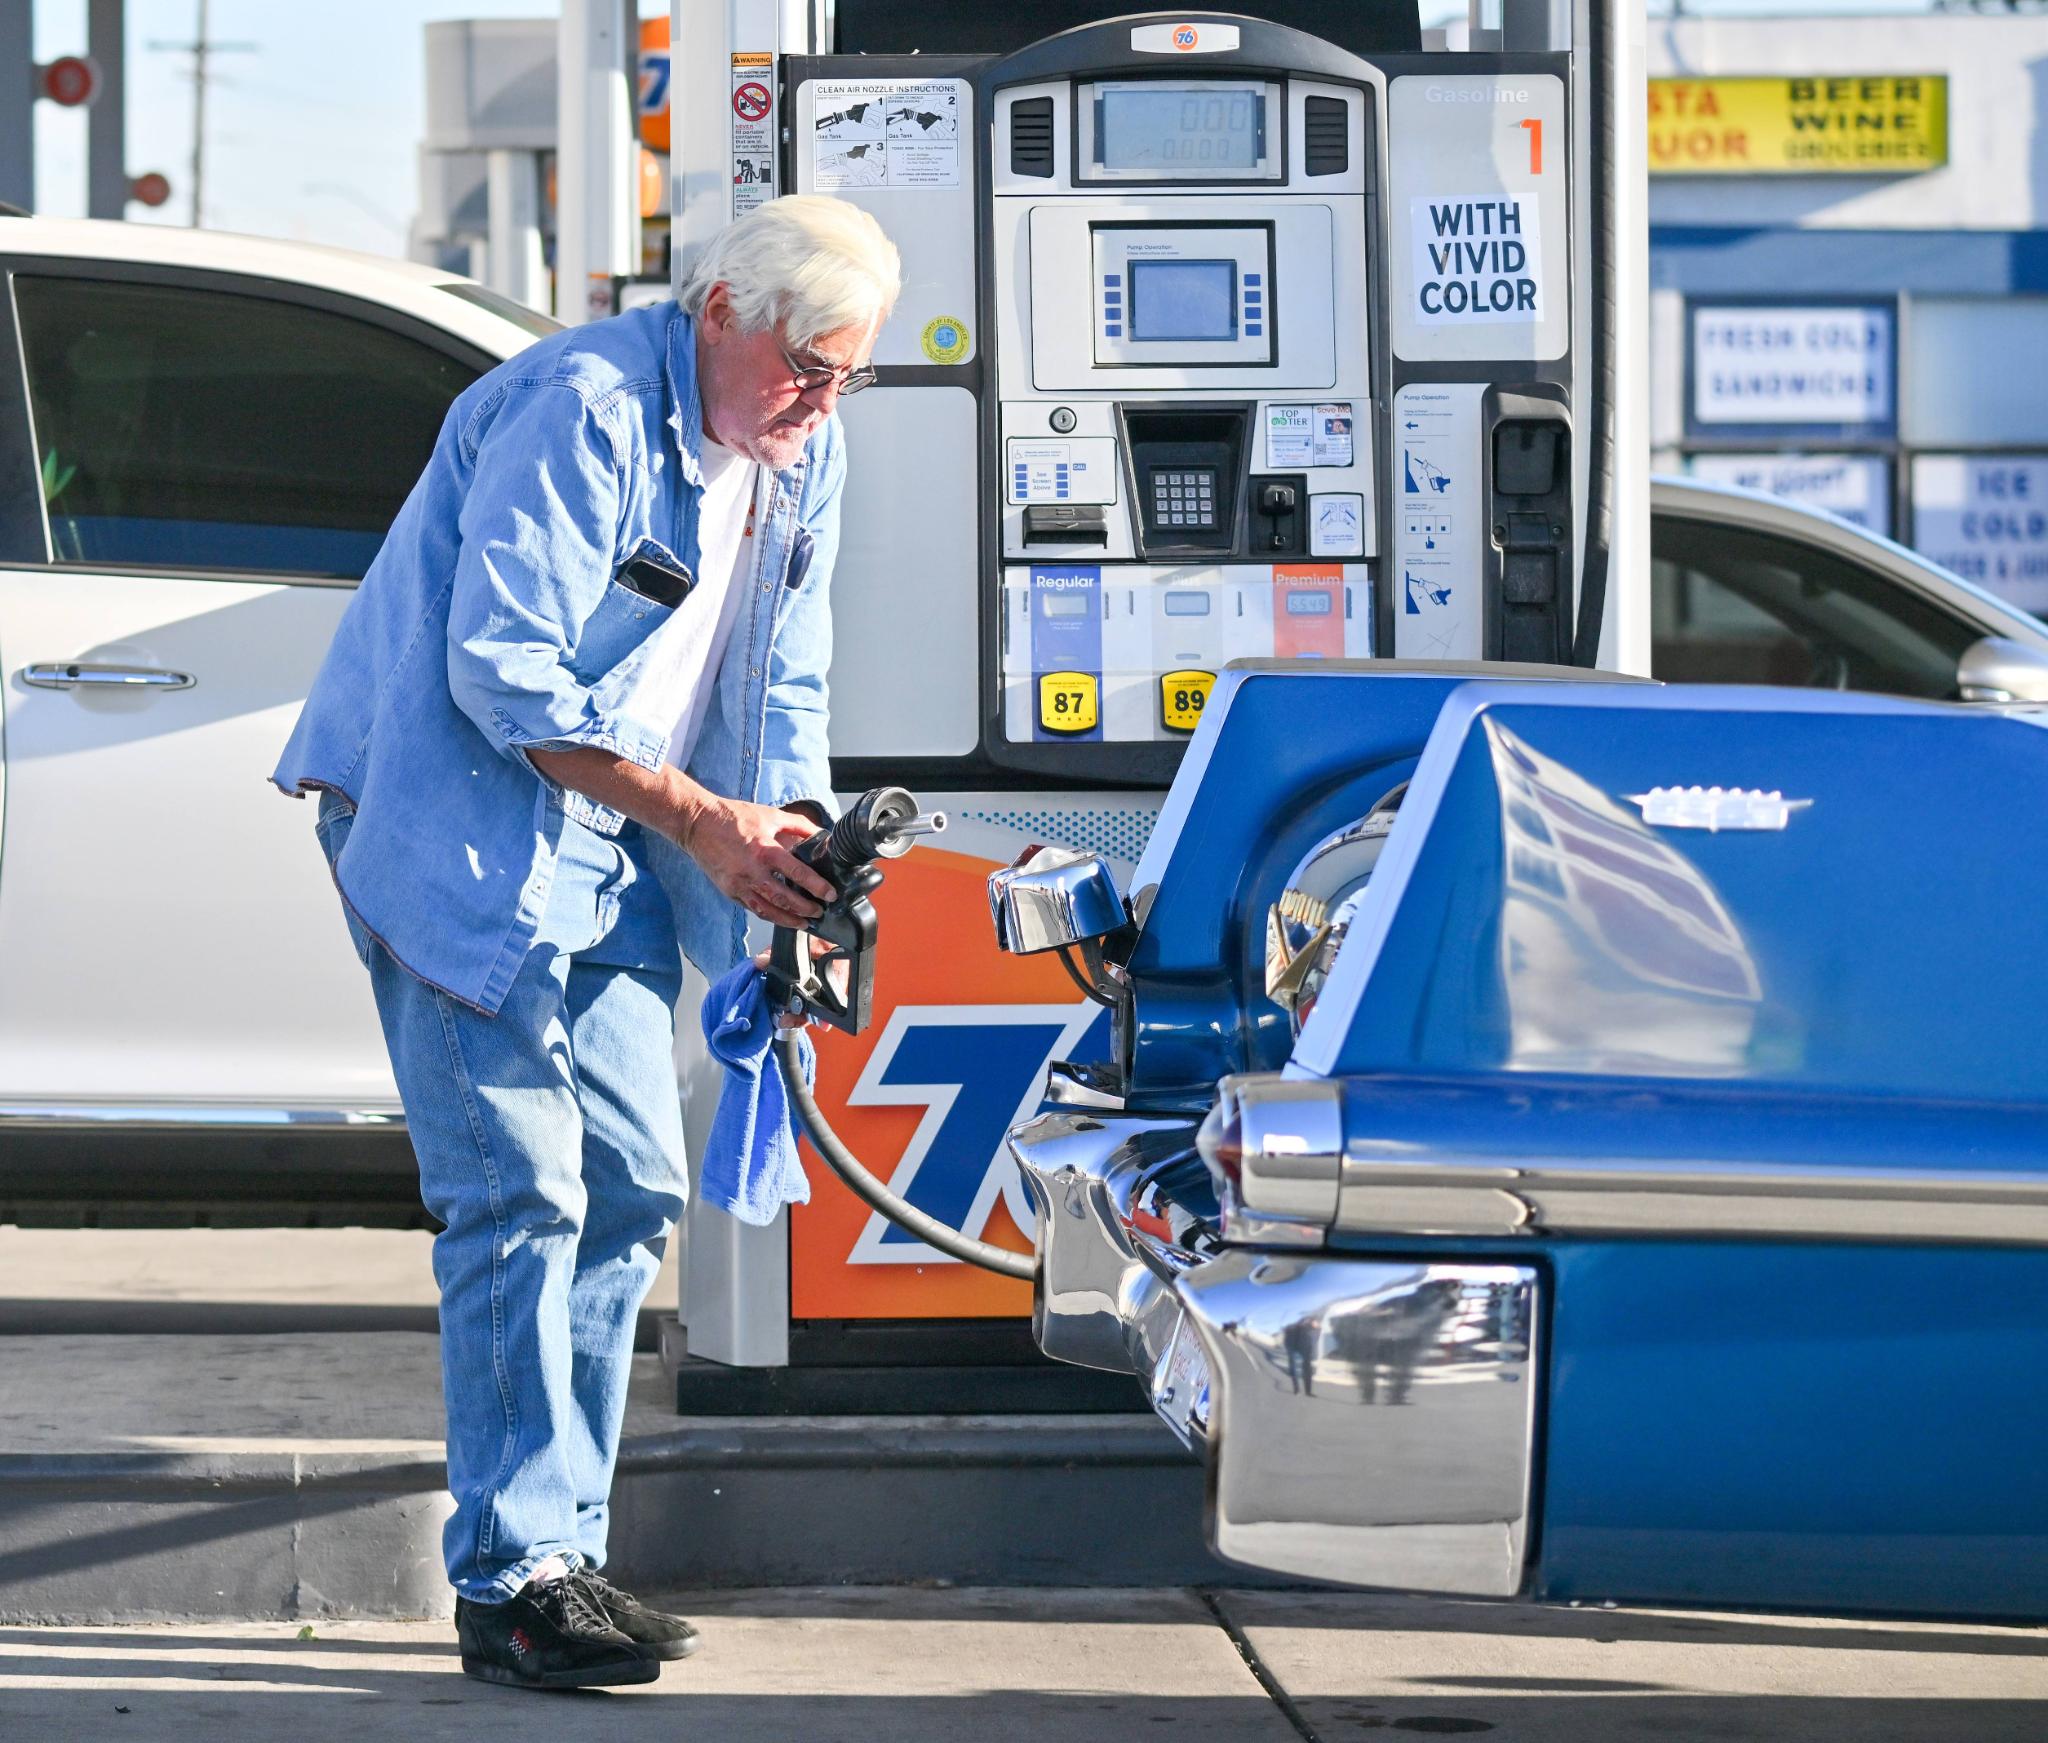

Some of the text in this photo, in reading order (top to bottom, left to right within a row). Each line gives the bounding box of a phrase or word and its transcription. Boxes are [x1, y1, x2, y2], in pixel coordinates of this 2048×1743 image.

[1177, 30, 1194, 45] 76
[896, 85, 956, 93] INSTRUCTIONS
[1424, 85, 1529, 103] Gasoline
[1787, 78, 1921, 101] BEER
[878, 97, 883, 105] 1
[948, 96, 956, 105] 2
[1790, 112, 1918, 130] WINE
[876, 142, 884, 151] 3
[1519, 118, 1543, 175] 1
[1429, 202, 1521, 237] WITH
[1427, 240, 1526, 275] VIVID
[1419, 278, 1537, 315] COLOR
[1706, 323, 1879, 348] FRESH COLD
[1280, 409, 1299, 417] TOP
[1316, 406, 1336, 414] Save
[1289, 418, 1308, 426] TIER
[1977, 468, 2030, 498] ICE
[1961, 511, 2046, 541] COLD
[1036, 575, 1095, 591] Regular
[1275, 573, 1341, 586] Premium
[1054, 692, 1084, 714] 87
[1174, 689, 1205, 712] 89
